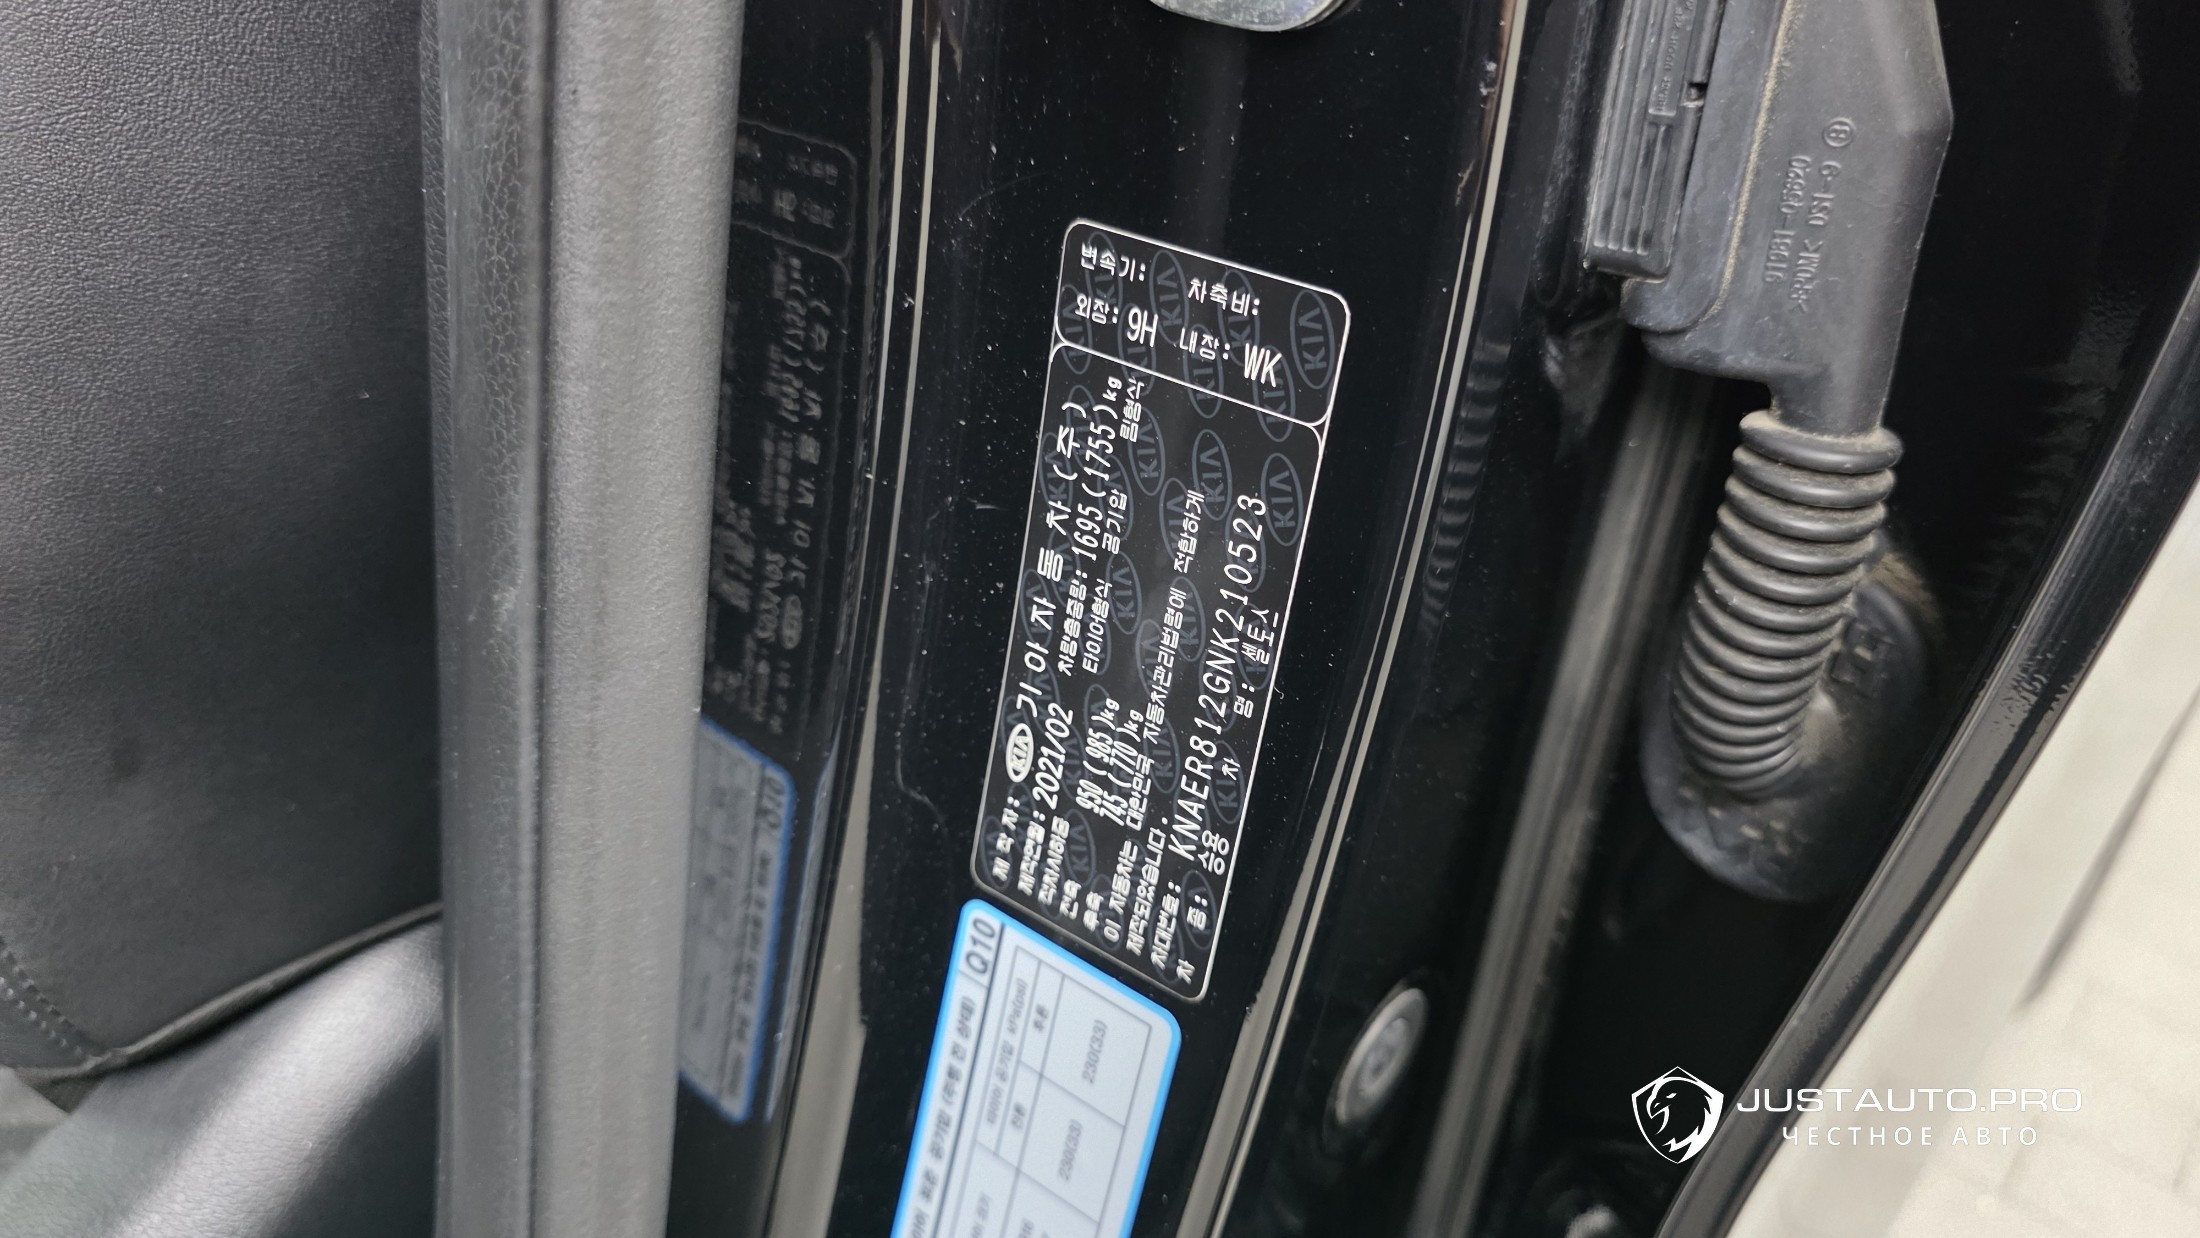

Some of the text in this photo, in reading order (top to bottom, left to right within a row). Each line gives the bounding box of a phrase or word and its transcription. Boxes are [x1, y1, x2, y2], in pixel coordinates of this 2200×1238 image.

[1075, 294, 1282, 387] 외장: 9H 내장: WK
[1081, 243, 1259, 317] 변속기: 차축비:
[1082, 579, 1112, 673] 타이어형식
[1102, 489, 1127, 554] 공기압
[1120, 376, 1144, 442] 림형식
[1032, 703, 1073, 809] 2021/02
[1058, 569, 1087, 676] 차량총중량:
[1104, 490, 1205, 942] 이 자동차는 대한민국 자동차관리법령에 적합하게
[1151, 495, 1266, 969] 차대번호: KNAER812GNK210523
[1198, 830, 1229, 875] 승용
[1241, 610, 1278, 664] 셀토스
[1076, 779, 1104, 815] 950
[1100, 791, 1131, 826] 745
[965, 918, 996, 975] Q10
[1057, 1019, 1107, 1183] 230(33) 230(33)
